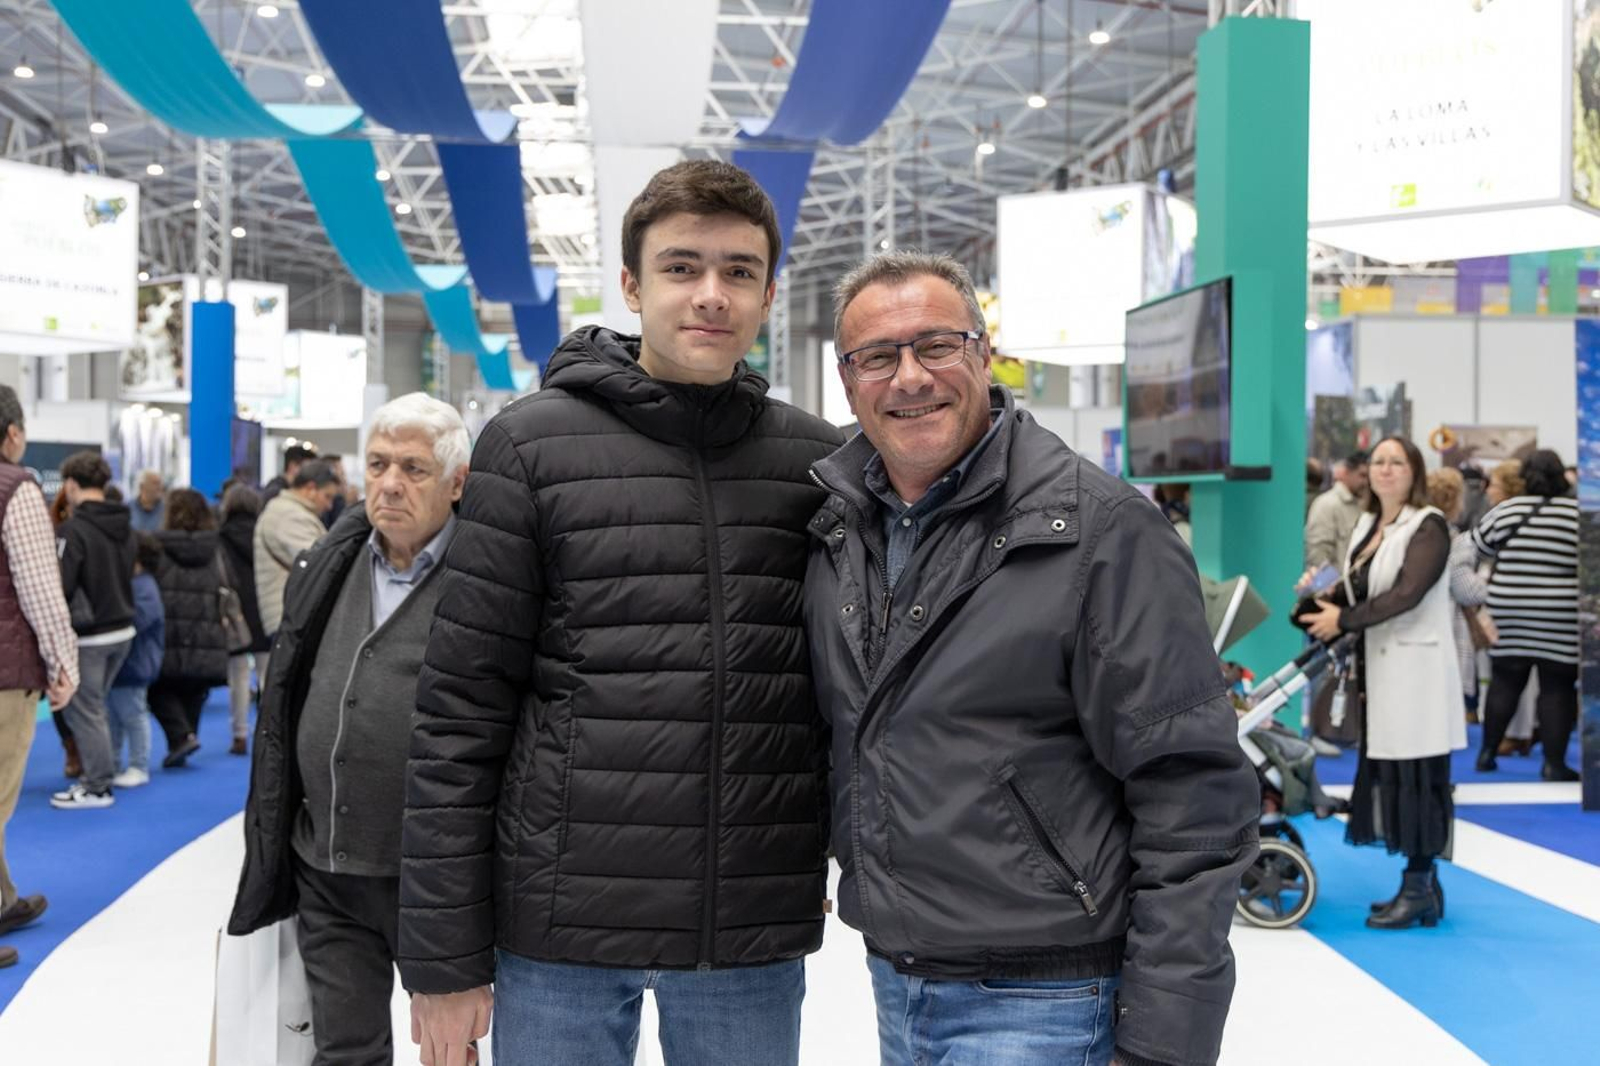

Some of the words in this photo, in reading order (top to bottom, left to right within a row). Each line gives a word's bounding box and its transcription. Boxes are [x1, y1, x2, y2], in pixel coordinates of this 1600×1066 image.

[1407, 98, 1469, 121] LOMA
[1373, 136, 1410, 154] LAS
[1416, 126, 1491, 147] VILLAS
